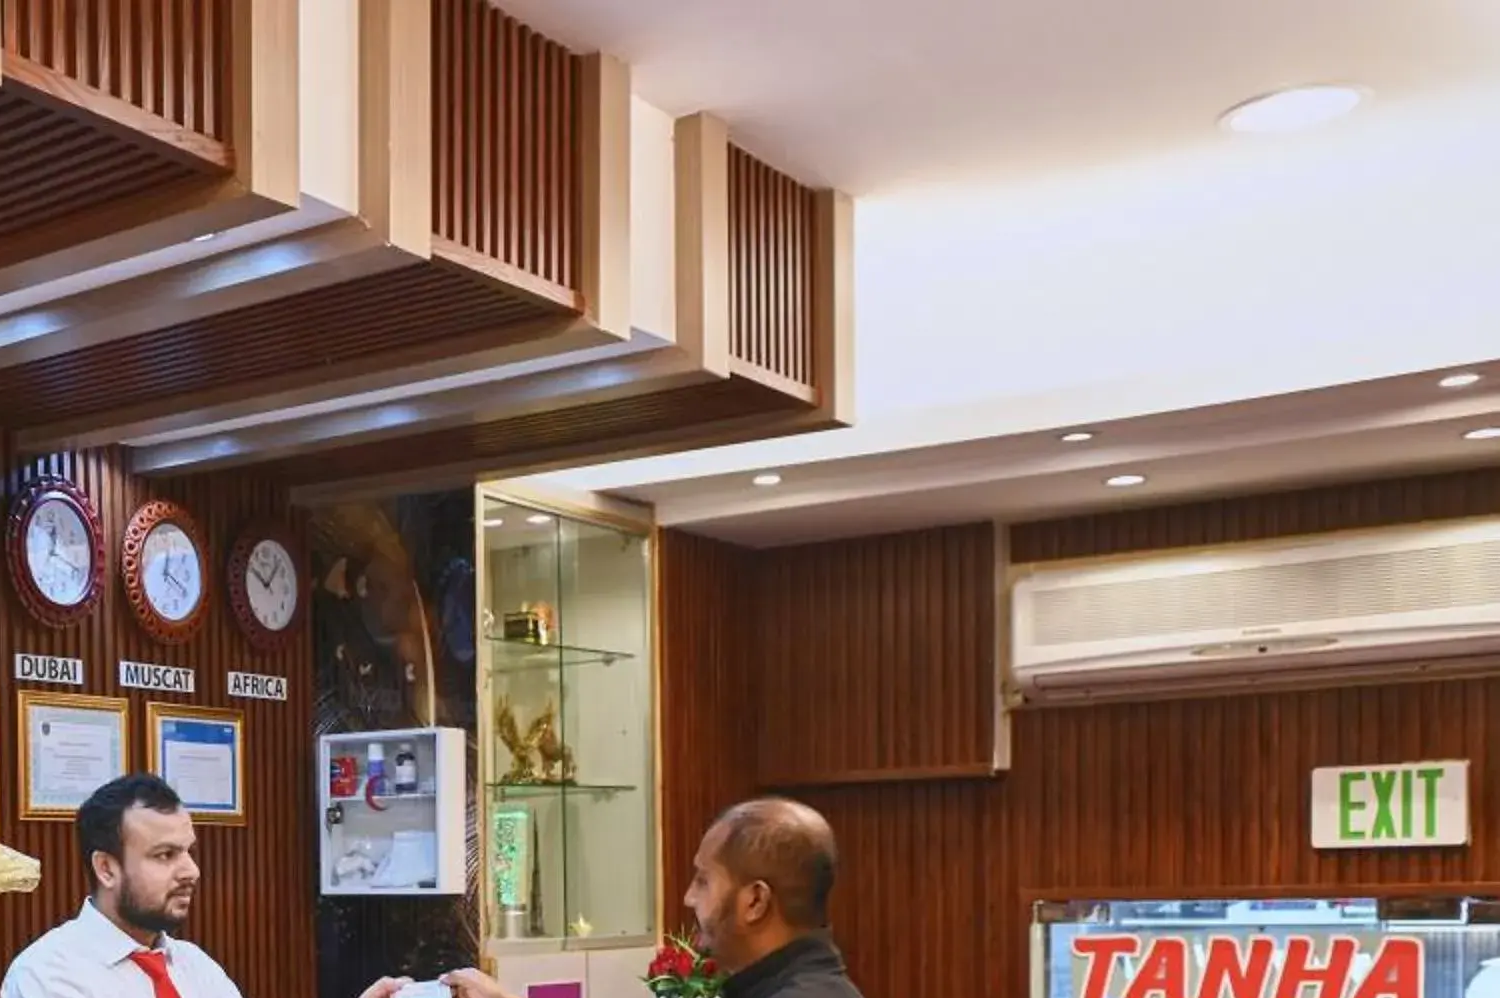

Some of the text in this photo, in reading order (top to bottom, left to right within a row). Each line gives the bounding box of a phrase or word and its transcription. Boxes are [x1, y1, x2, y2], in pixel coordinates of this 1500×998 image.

[21, 656, 78, 682] DUBAI
[125, 664, 191, 691] MUSCAT
[233, 676, 284, 698] AFRICA
[1338, 768, 1445, 840] EXIT
